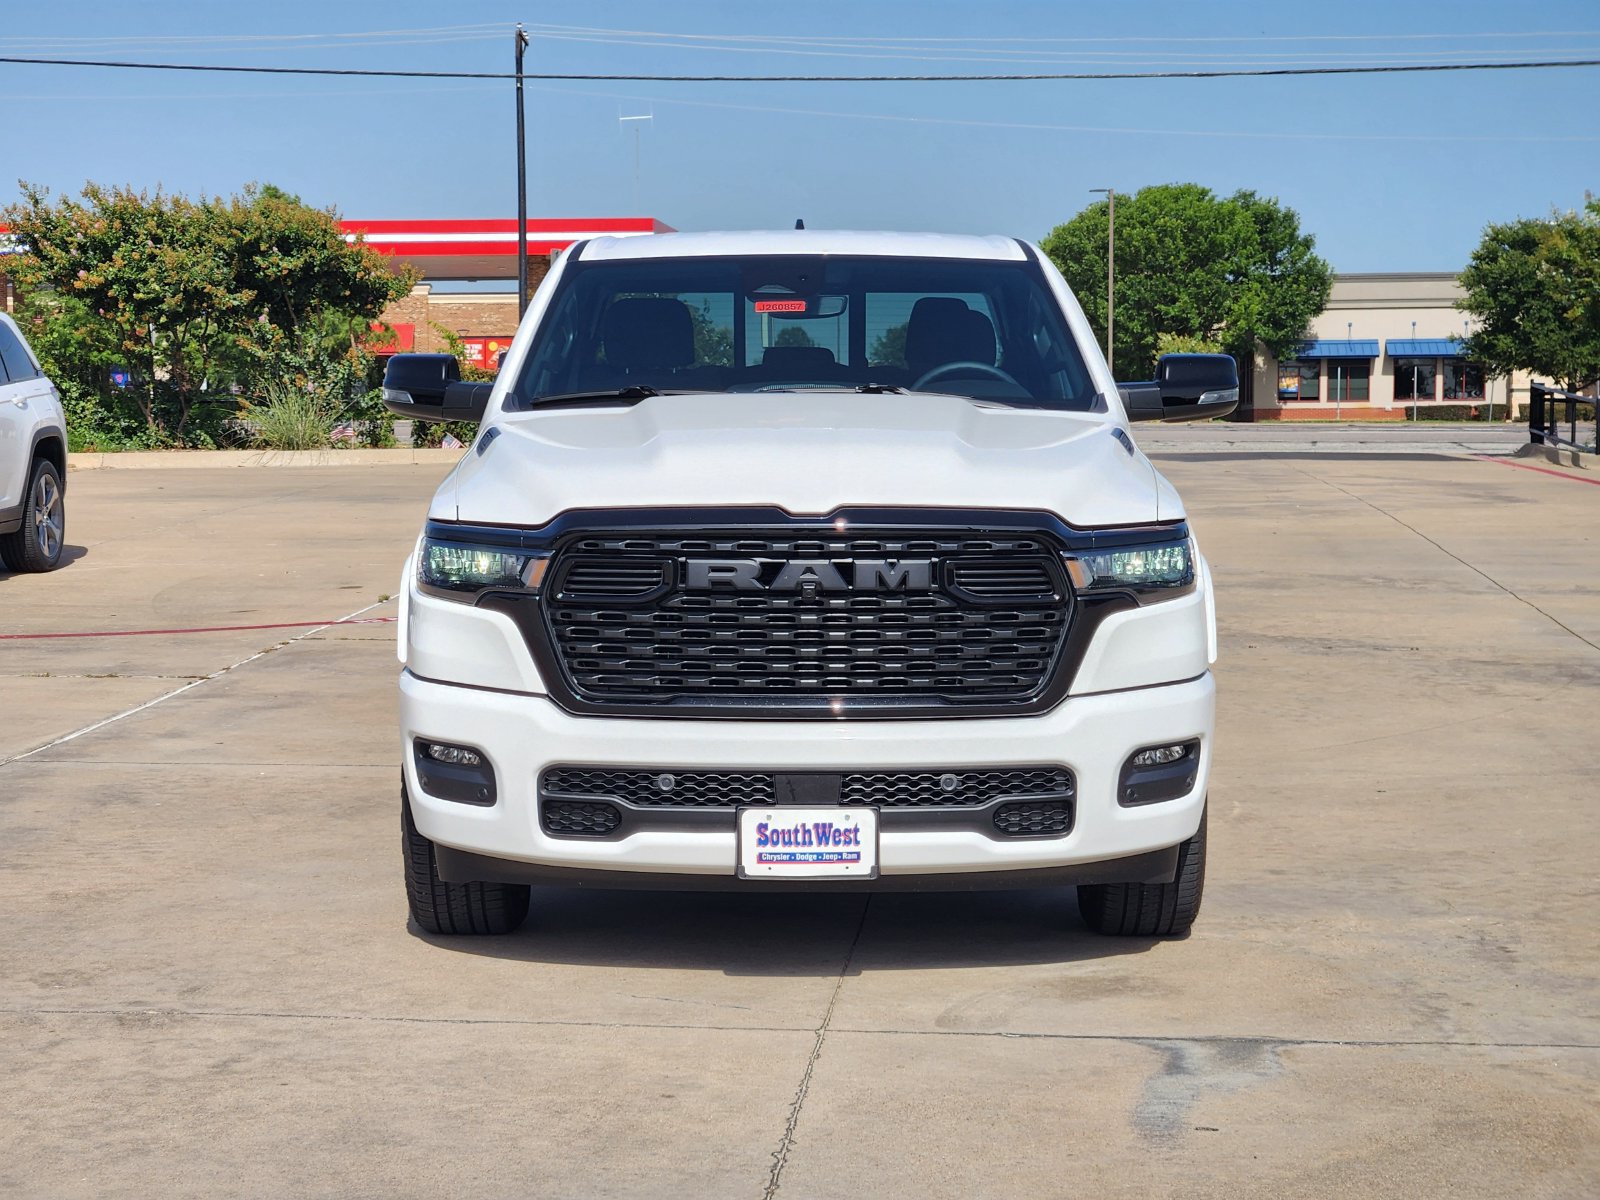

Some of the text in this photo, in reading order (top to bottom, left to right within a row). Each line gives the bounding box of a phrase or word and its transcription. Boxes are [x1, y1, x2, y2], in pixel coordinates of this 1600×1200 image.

[759, 303, 802, 311] J260857
[680, 557, 937, 591] RAM
[756, 822, 860, 848] SouthWest
[761, 852, 858, 862] Chrysler Dodge Jeep Ram
